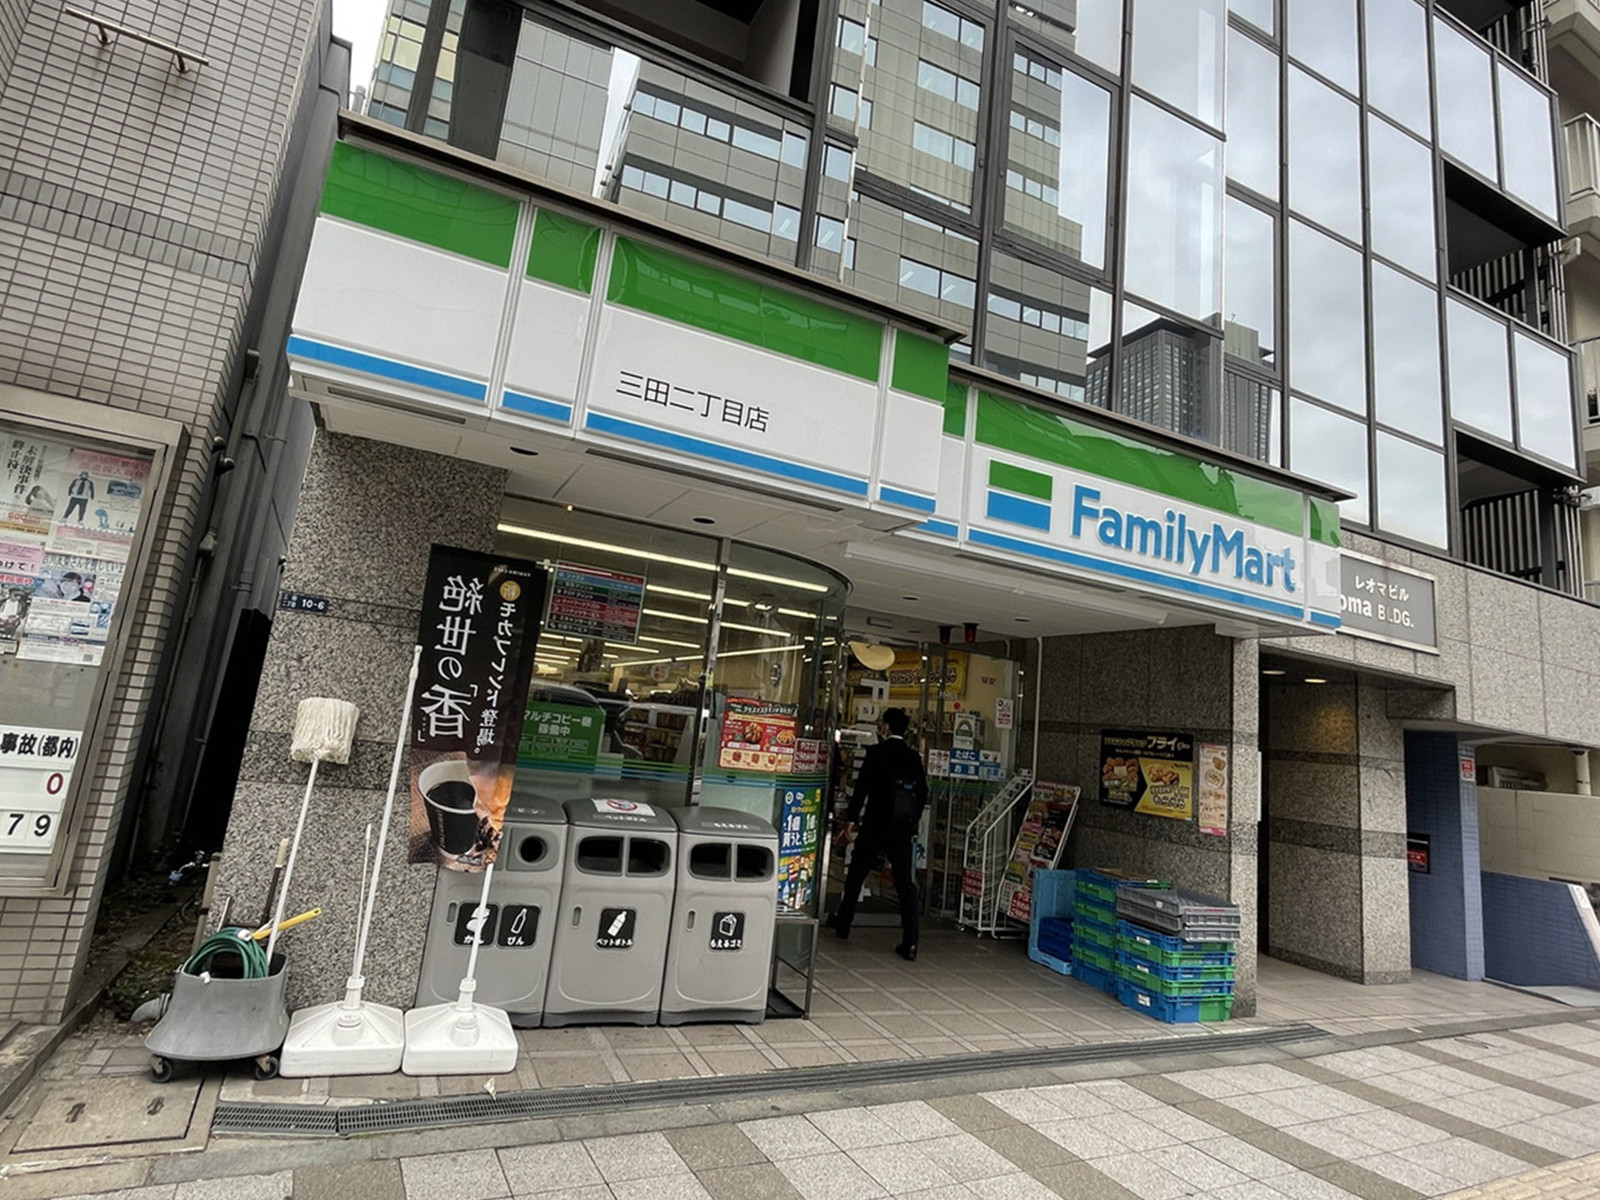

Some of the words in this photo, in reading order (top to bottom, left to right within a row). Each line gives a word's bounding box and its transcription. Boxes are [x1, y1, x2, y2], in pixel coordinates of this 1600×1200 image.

[616, 371, 769, 433] 三田二丁目店
[1071, 484, 1296, 593] FamilyMart
[1355, 575, 1410, 602] レオマビル
[302, 599, 325, 610] 10-6
[1377, 603, 1414, 628] BLDG.
[955, 750, 976, 761] たばこ
[46, 772, 64, 795] 0
[507, 935, 524, 946] びん
[596, 937, 633, 948] ペットボトル
[710, 938, 742, 949] もえるゴミ
